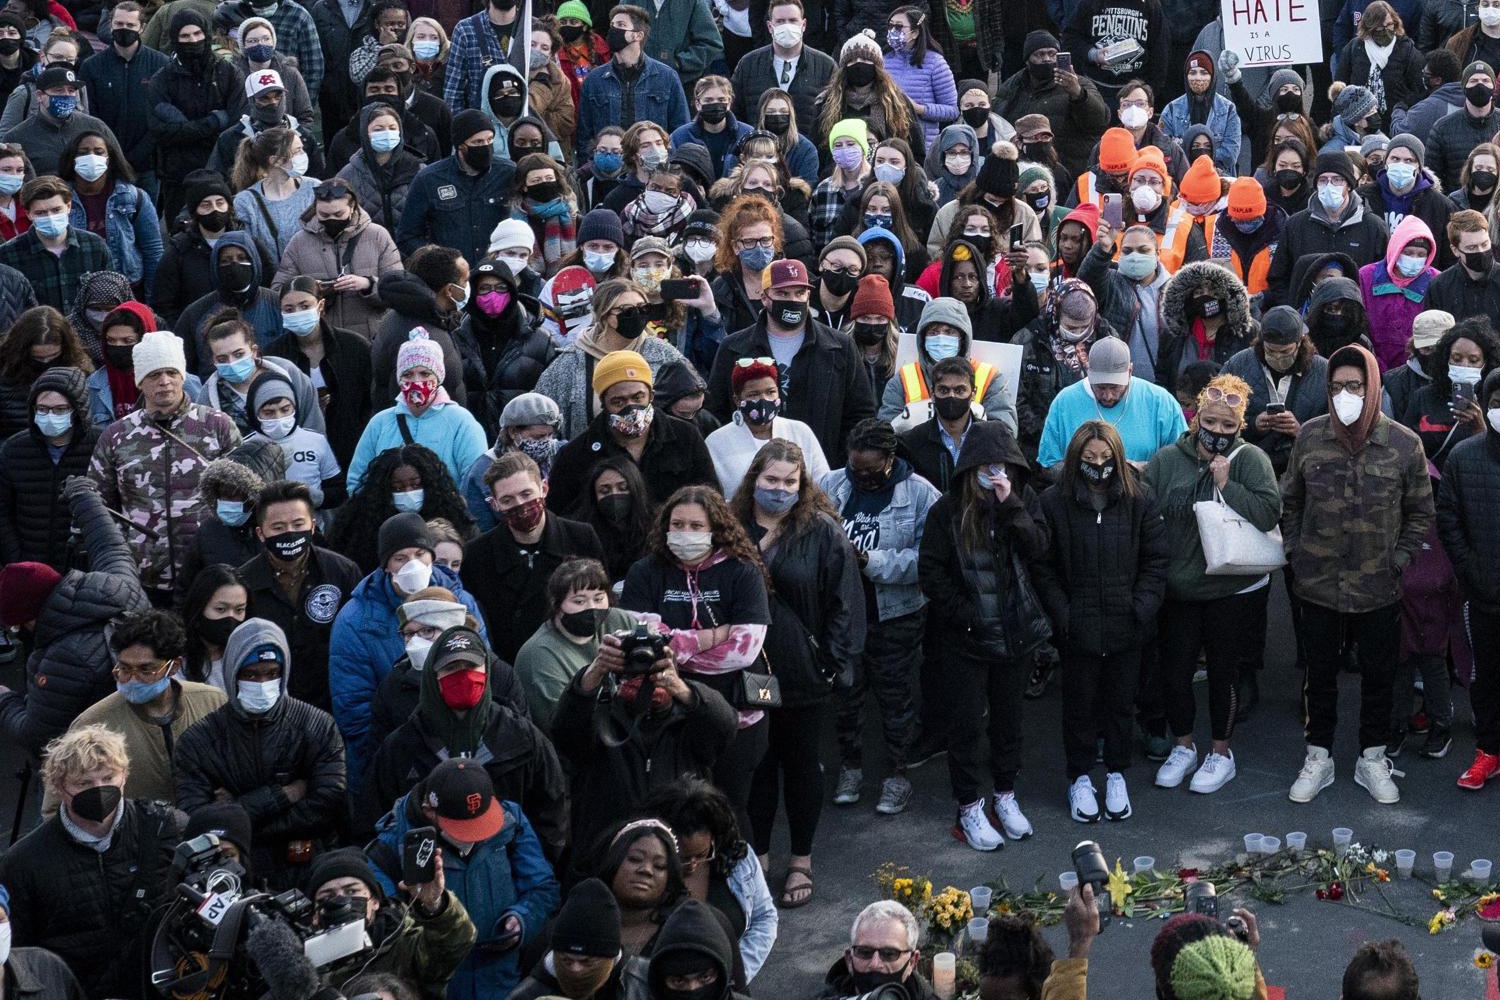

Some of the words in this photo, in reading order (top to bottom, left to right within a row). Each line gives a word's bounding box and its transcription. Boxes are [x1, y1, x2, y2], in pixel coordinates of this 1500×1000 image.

[1105, 8, 1140, 16] PITTSBURGH
[1092, 14, 1148, 42] PENGUINS
[1244, 44, 1292, 61] VIRUS
[208, 898, 225, 920] AP
